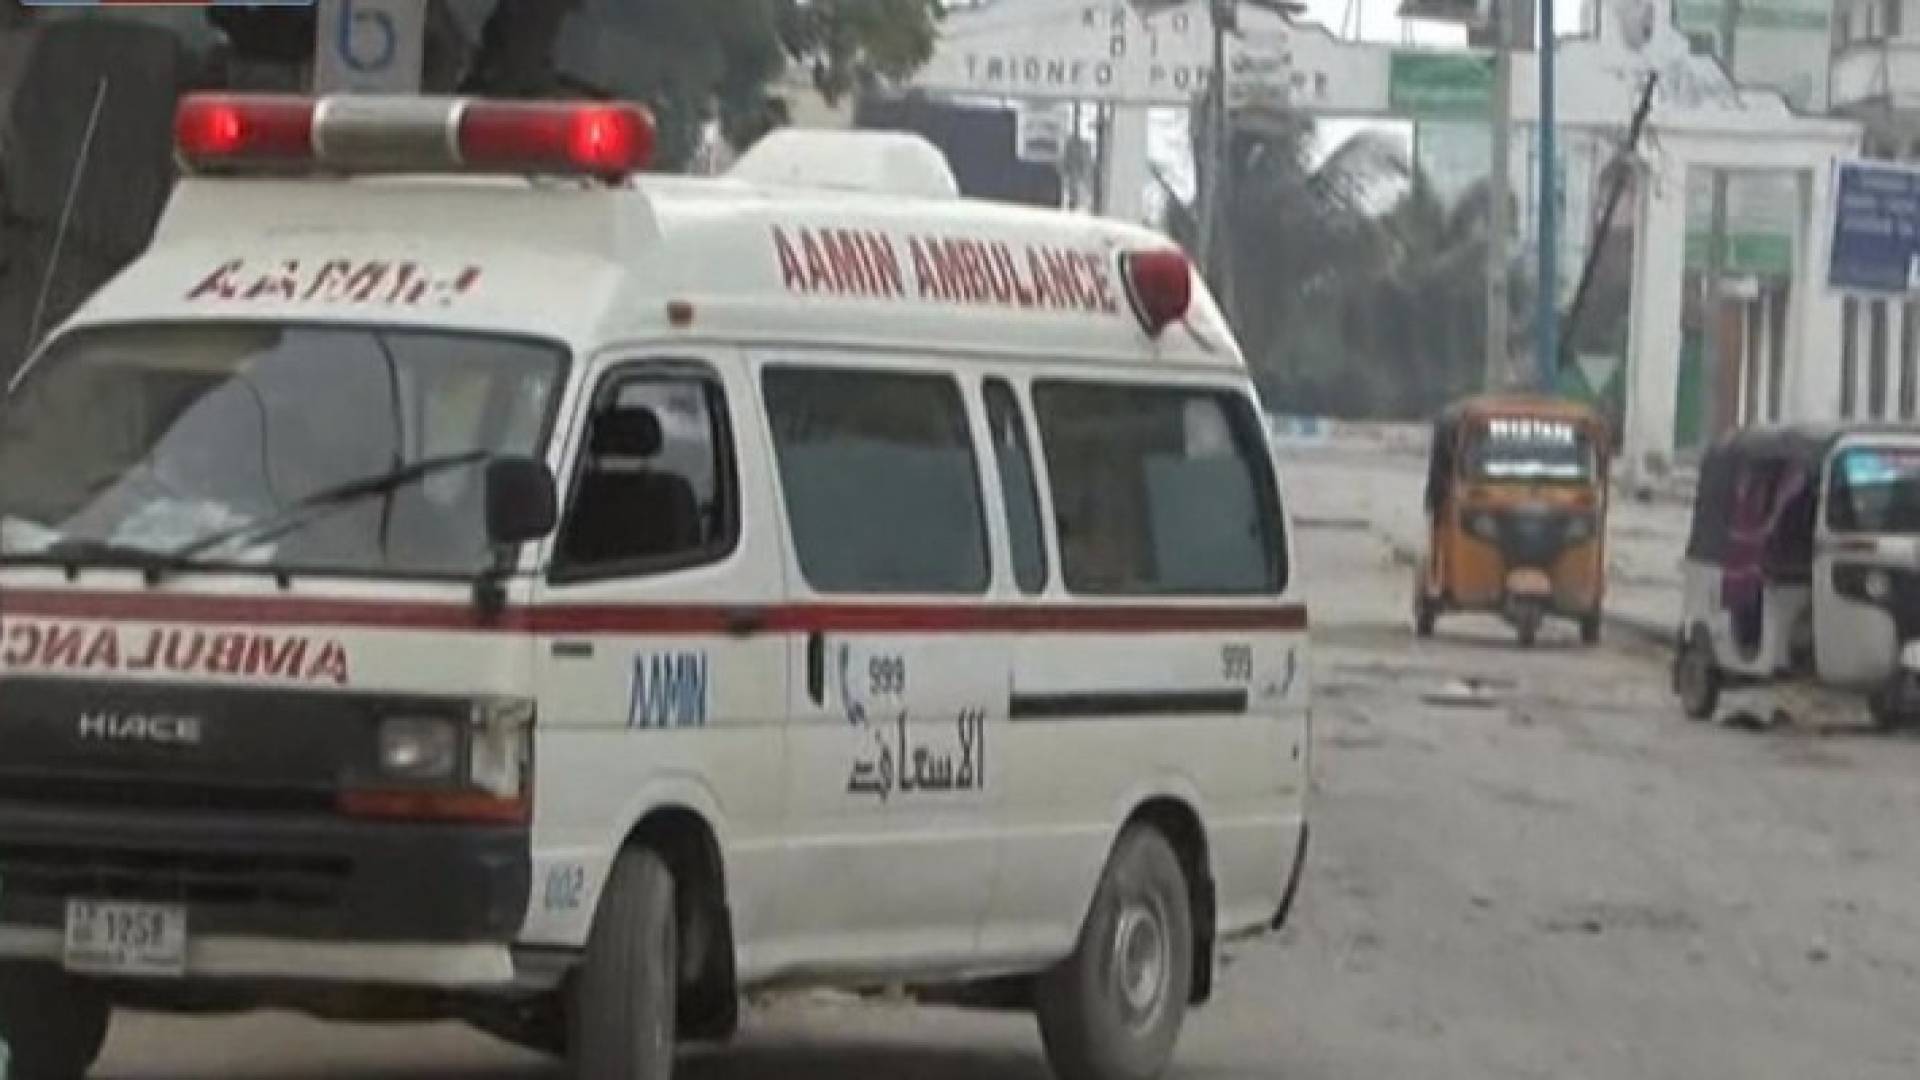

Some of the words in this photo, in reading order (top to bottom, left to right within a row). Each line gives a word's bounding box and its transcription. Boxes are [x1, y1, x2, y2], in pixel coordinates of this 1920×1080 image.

[771, 223, 905, 297] AAMIN
[909, 233, 1119, 314] AMBULANCE
[868, 654, 905, 695] 999
[1222, 643, 1252, 681] 999
[627, 652, 707, 728] AAMIN
[79, 711, 201, 744] HIACE
